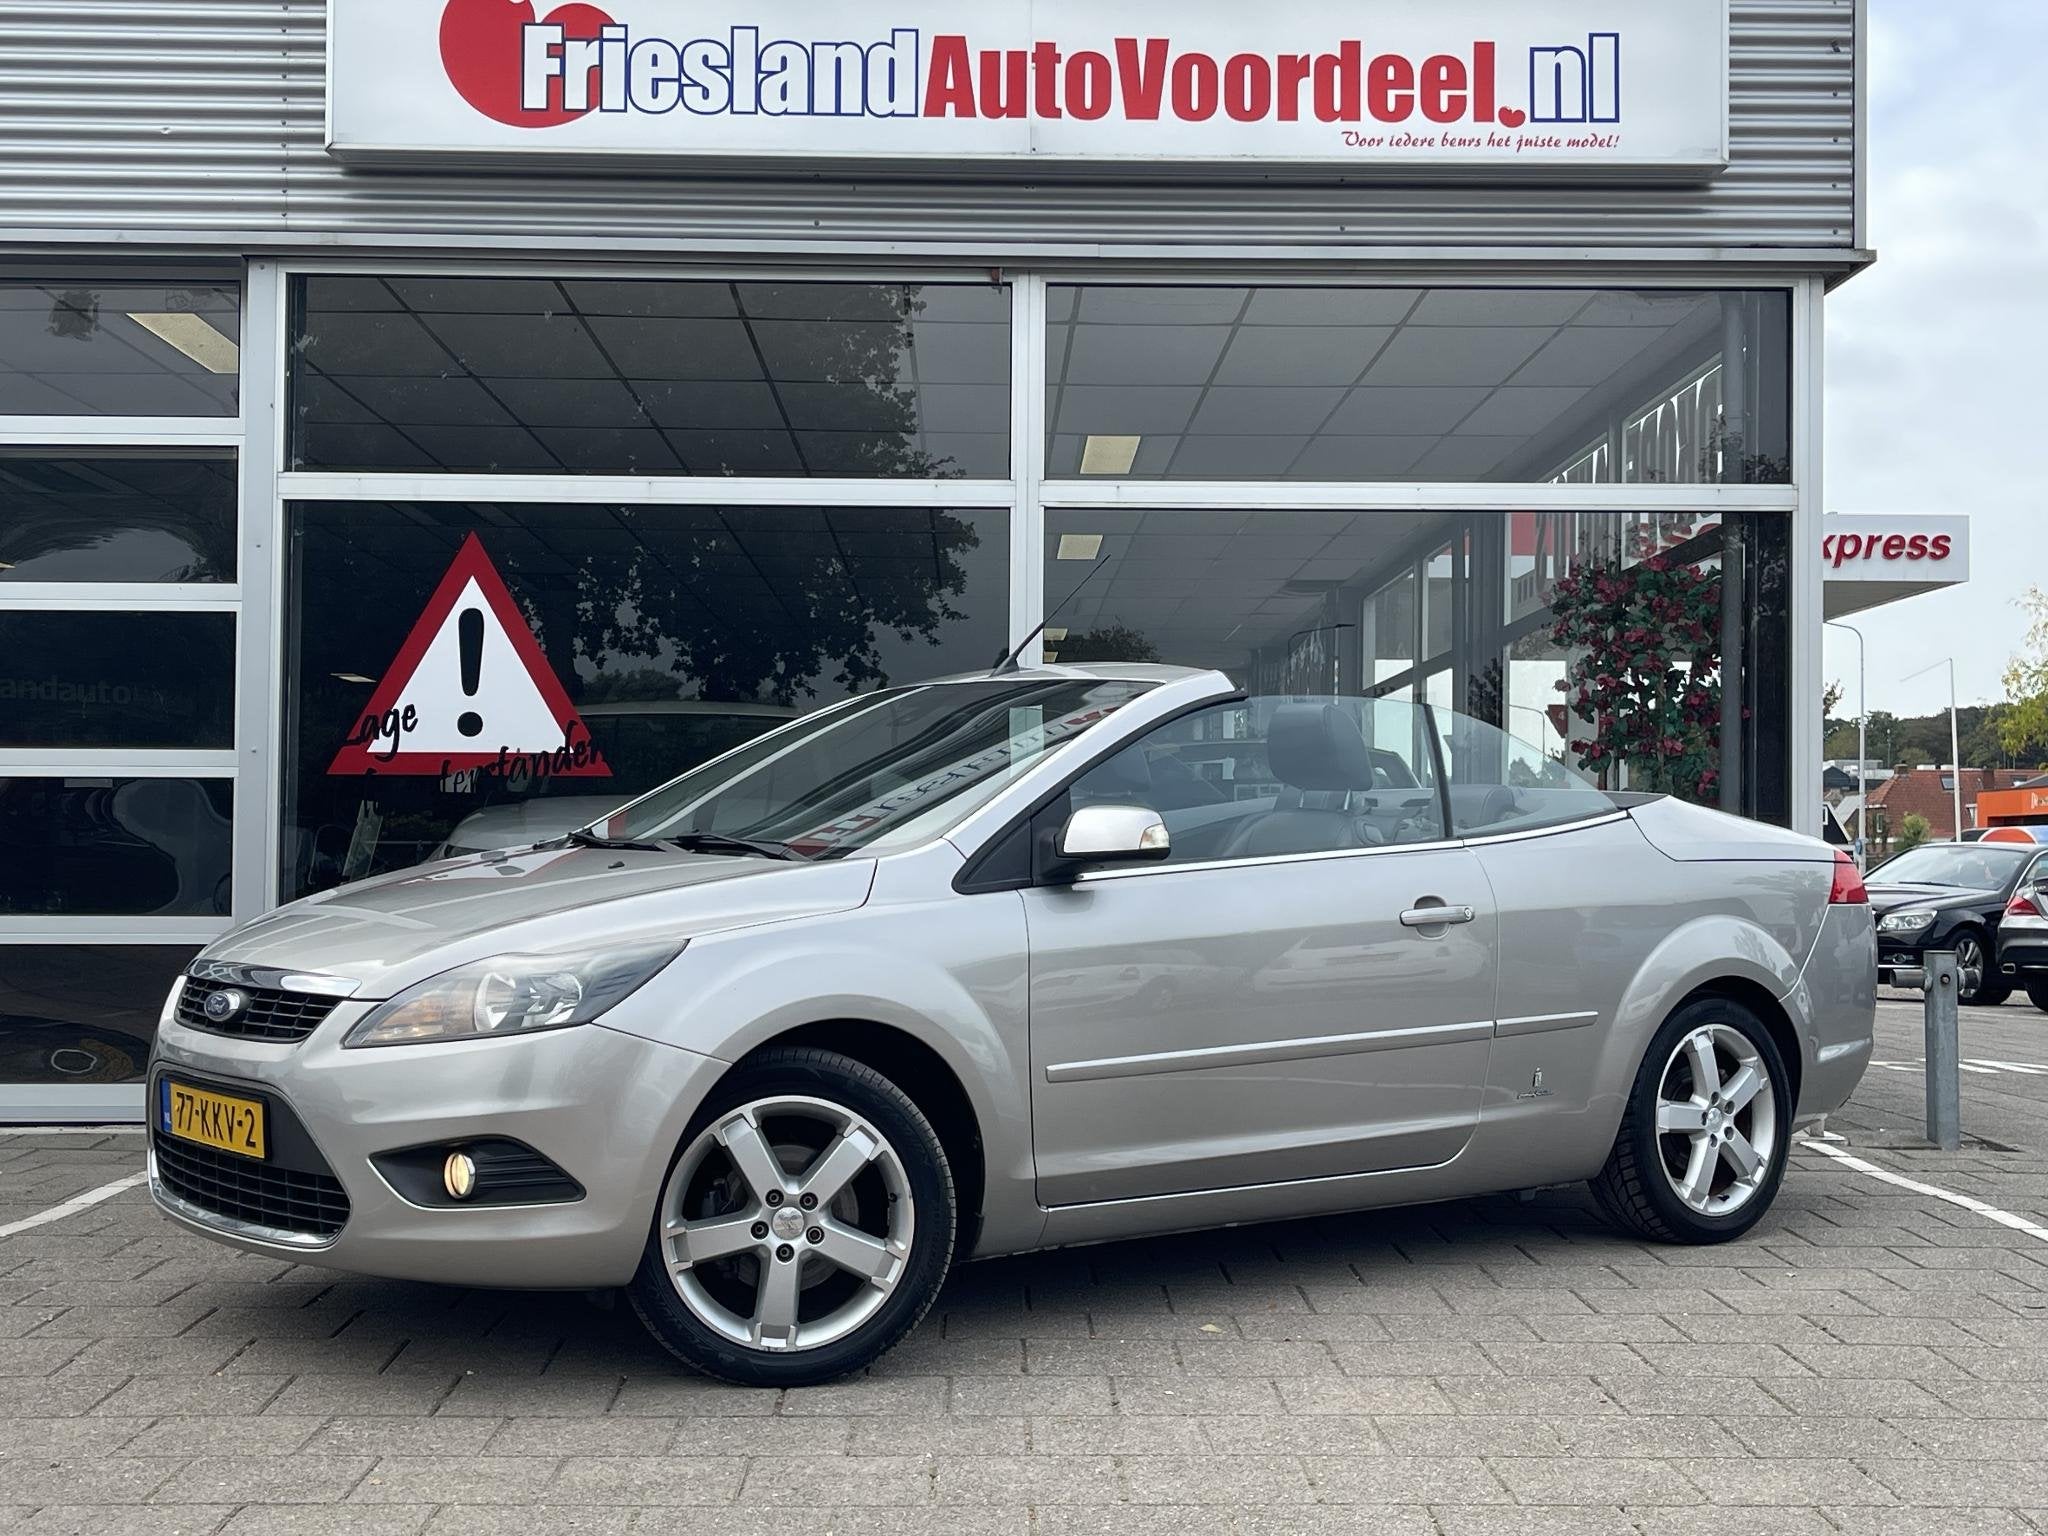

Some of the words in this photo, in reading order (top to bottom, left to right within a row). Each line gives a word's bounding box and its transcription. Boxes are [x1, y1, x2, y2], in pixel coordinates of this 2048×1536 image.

[520, 23, 1621, 127] FrieslandAutoVoordeel.nl
[1341, 131, 1384, 148] Voor
[1389, 132, 1435, 148] iedere
[1441, 132, 1482, 148] beurs
[1487, 131, 1511, 148] het
[1515, 133, 1561, 153] juiste
[1566, 133, 1621, 149] model!
[176, 1091, 257, 1148] 77-KKV-2
